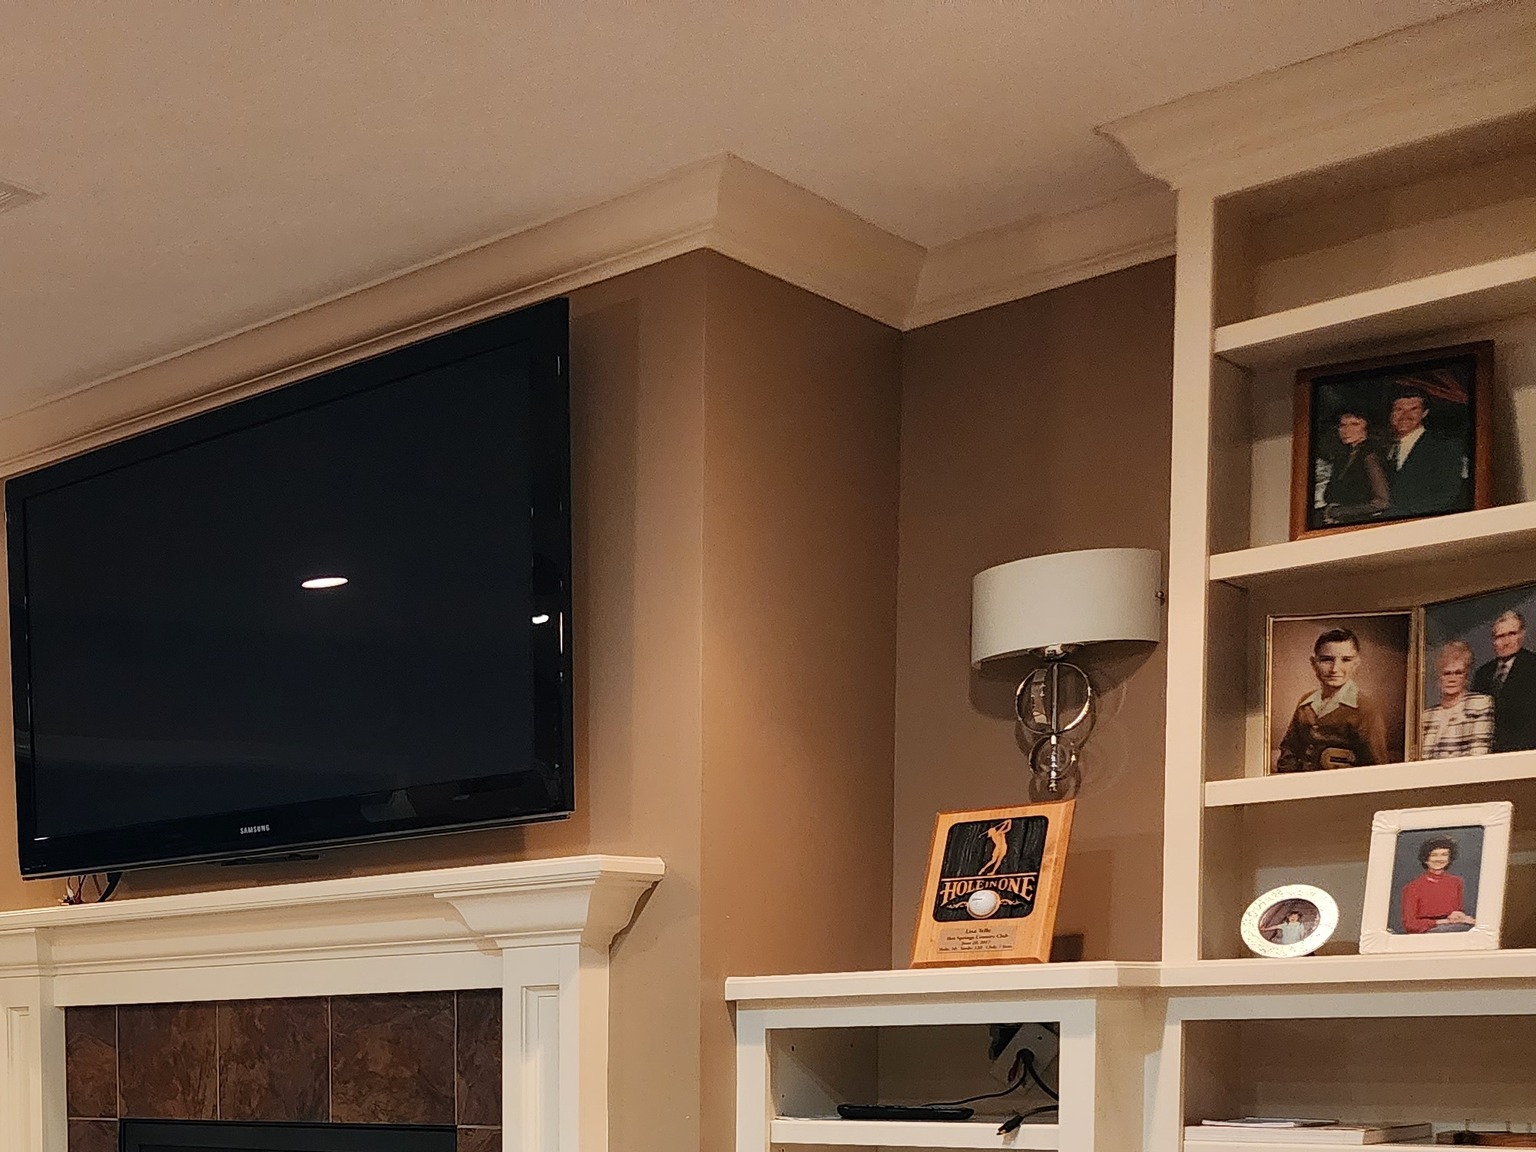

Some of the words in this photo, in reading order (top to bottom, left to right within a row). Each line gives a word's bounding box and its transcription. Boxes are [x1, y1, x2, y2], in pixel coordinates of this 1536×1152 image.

[239, 824, 271, 835] SAMSUNG
[939, 880, 984, 906] HOLE
[985, 880, 998, 888] IN
[998, 876, 1035, 901] ONE
